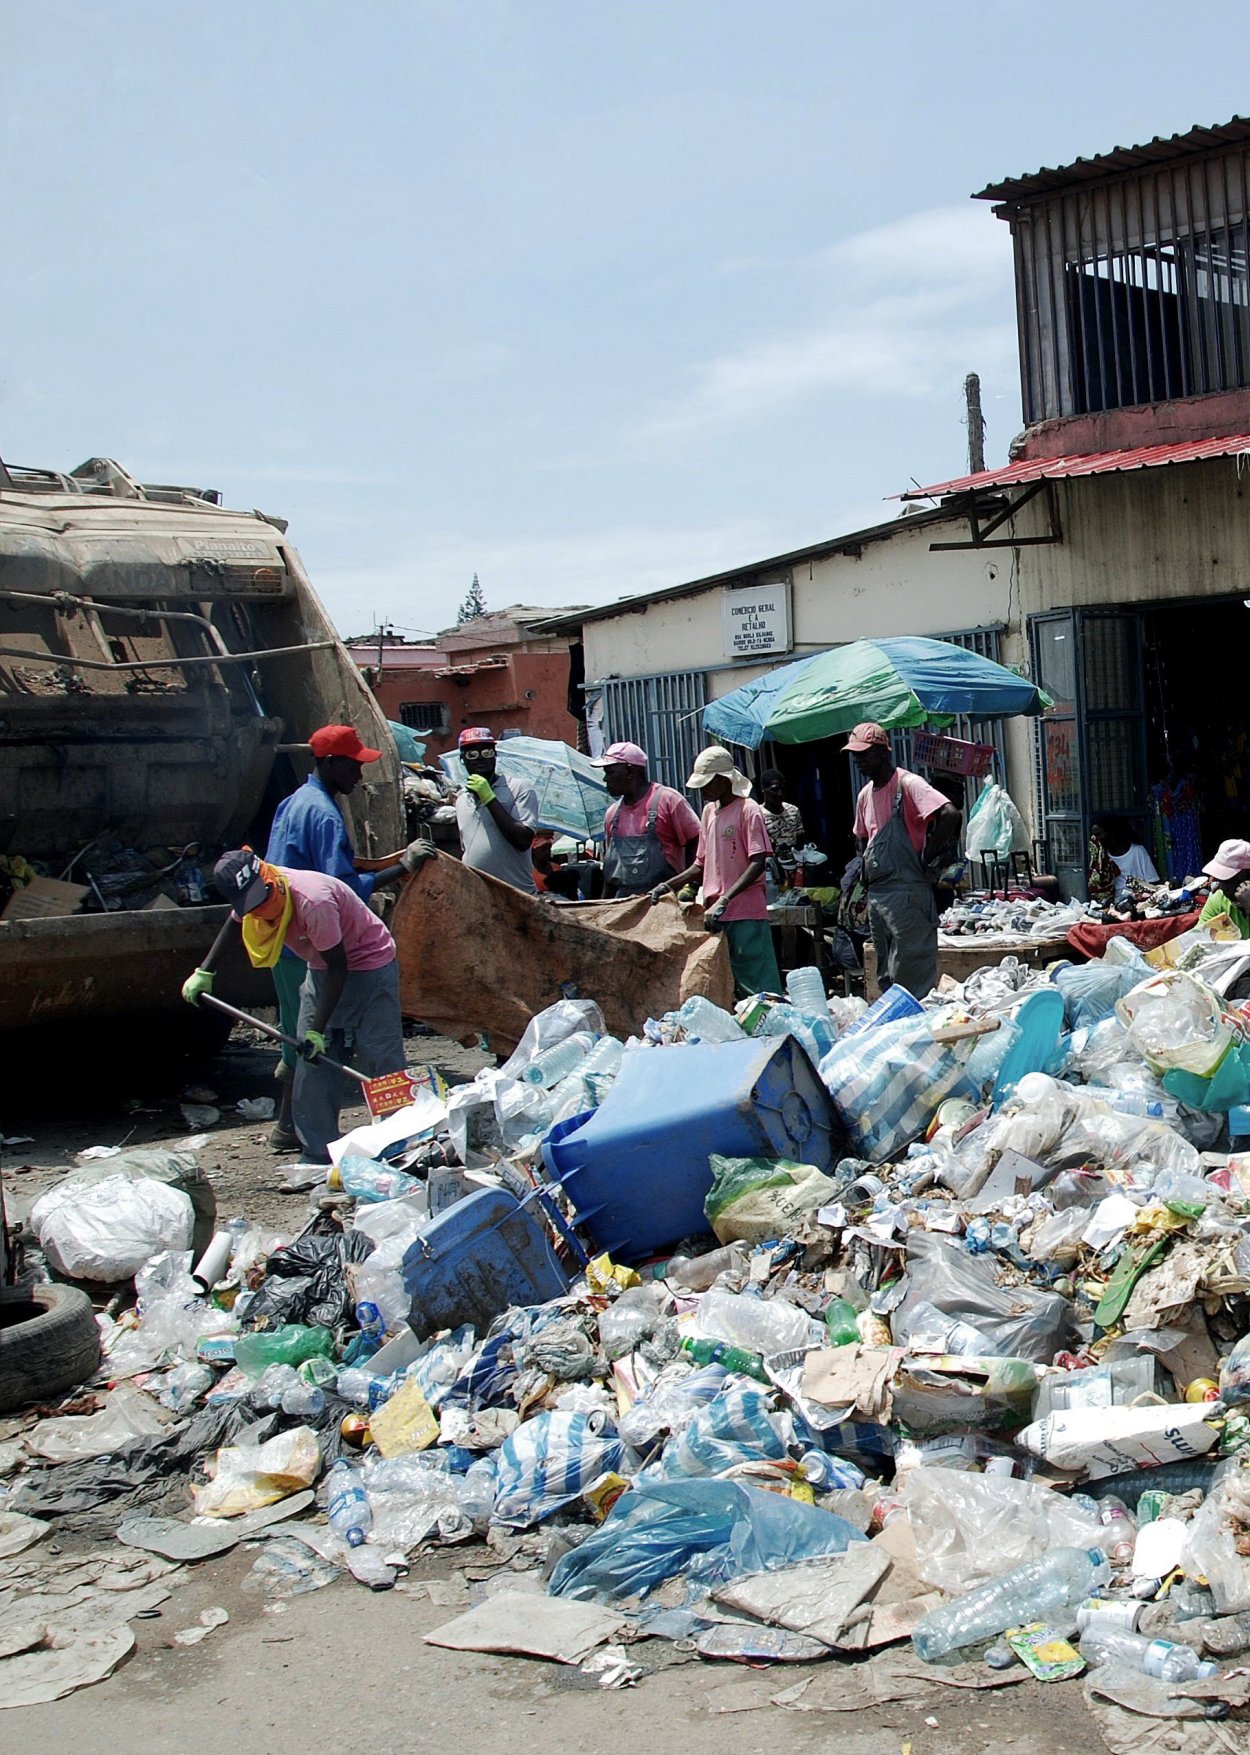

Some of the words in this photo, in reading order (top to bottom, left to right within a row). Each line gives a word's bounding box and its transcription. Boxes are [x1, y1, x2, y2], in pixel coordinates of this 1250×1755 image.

[194, 540, 256, 552] Planalto
[758, 603, 776, 613] GERAL
[748, 614, 752, 622] E
[755, 613, 759, 621] A
[741, 621, 766, 631] RETALHO
